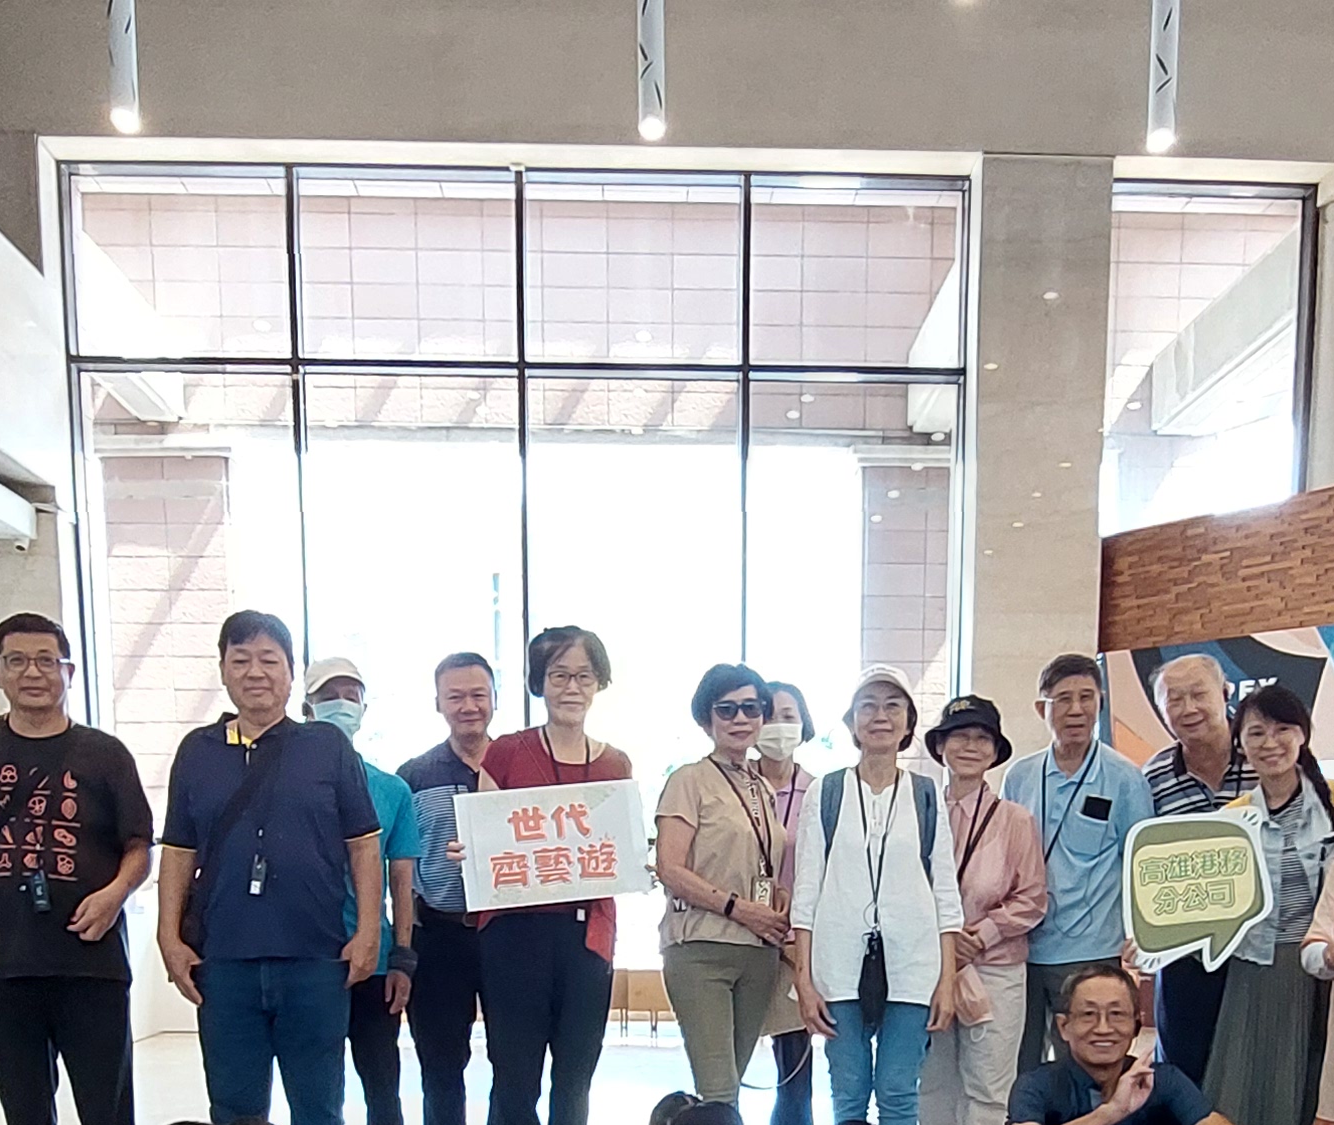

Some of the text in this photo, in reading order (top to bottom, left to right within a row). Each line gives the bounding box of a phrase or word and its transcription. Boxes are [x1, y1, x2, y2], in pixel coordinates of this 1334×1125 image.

[507, 803, 592, 842] 世代
[490, 842, 618, 889] 齊藝遊
[1138, 846, 1248, 886] 高雄港務
[1152, 879, 1236, 916] 分公司
